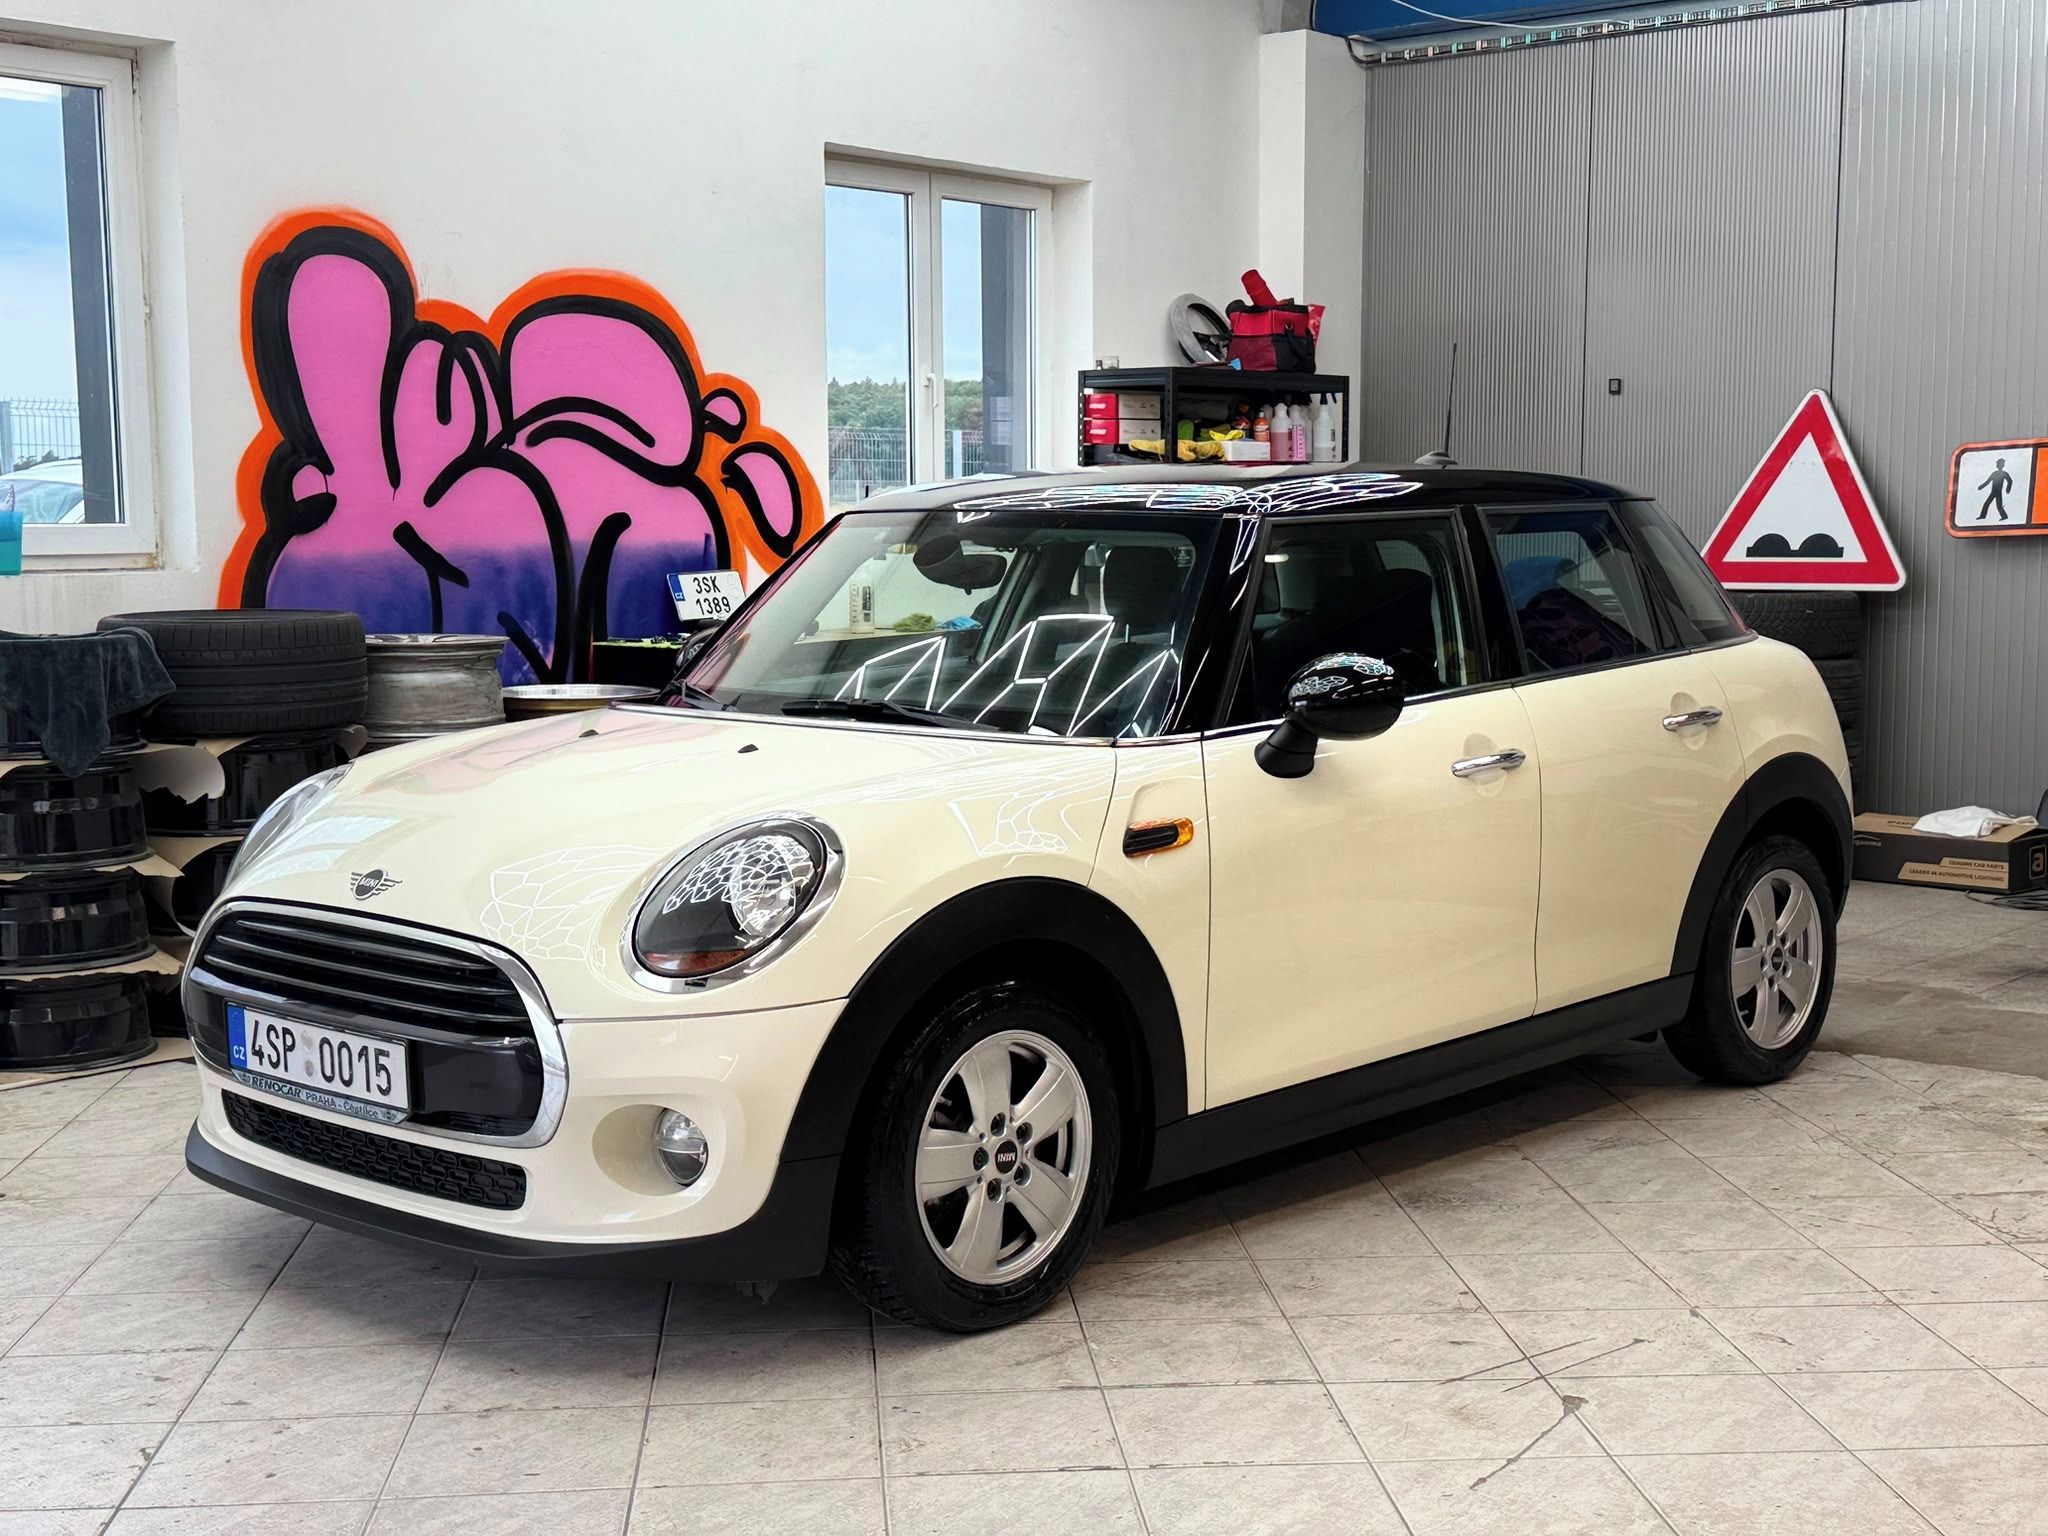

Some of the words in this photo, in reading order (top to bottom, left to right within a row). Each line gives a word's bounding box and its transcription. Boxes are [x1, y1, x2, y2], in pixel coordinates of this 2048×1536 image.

[693, 576, 721, 594] 3SK
[696, 596, 731, 615] 1389
[359, 877, 379, 888] MINI
[233, 1045, 246, 1060] CZ
[251, 1019, 296, 1073] 4SP
[319, 1036, 392, 1097] 0015
[252, 1076, 301, 1098] RENOCAR
[305, 1091, 337, 1108] PRAHA
